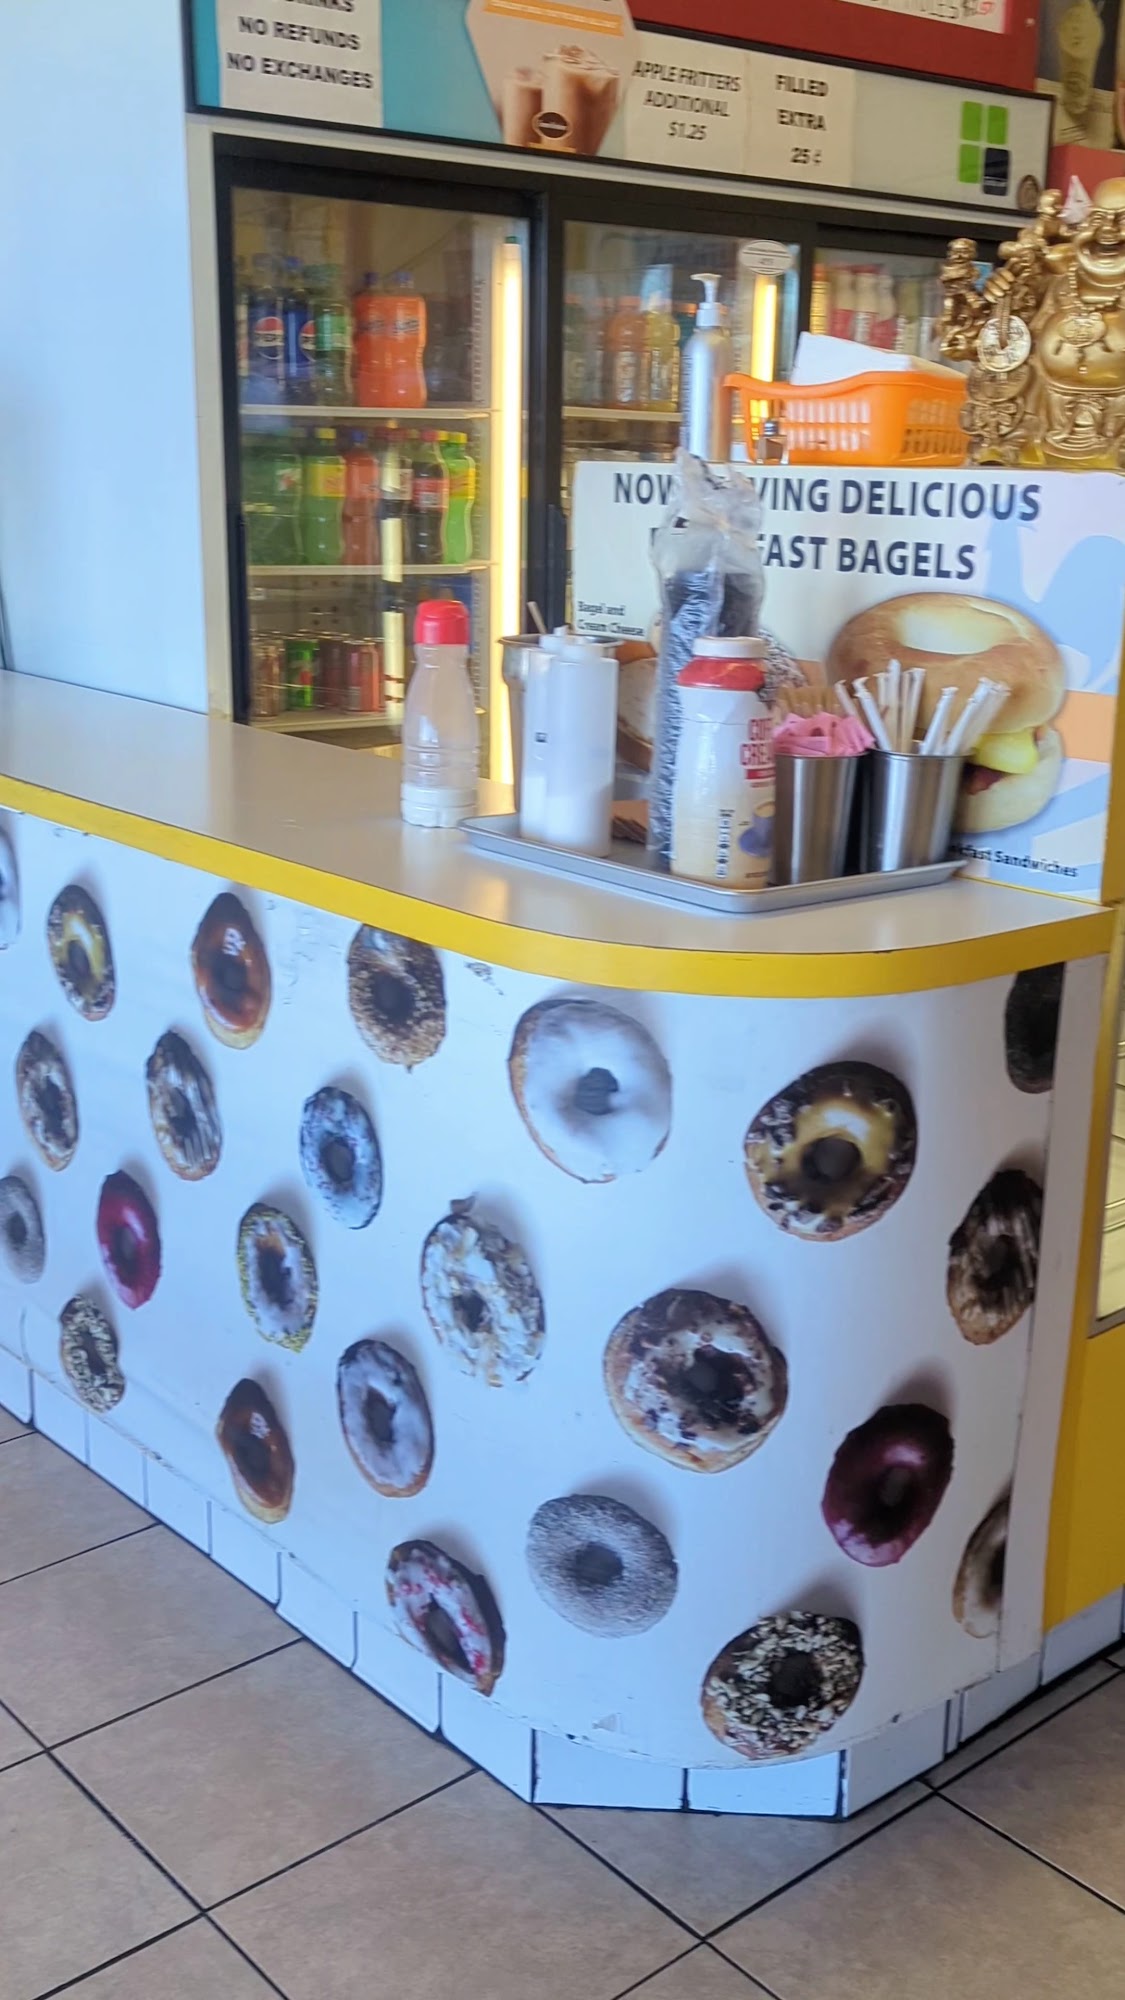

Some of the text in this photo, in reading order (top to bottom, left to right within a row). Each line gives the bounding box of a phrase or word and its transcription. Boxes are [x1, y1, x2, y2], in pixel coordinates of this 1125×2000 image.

[238, 16, 360, 50] NO REFUNDS
[227, 52, 374, 89] NO EXCHANGES
[632, 60, 742, 92] APPLE FRITTERS
[775, 74, 829, 97] FILLED
[643, 90, 730, 117] ADDITIONAL
[667, 121, 707, 140] $1.25
[776, 108, 827, 131] EXTRA
[790, 147, 810, 164] 25
[840, 479, 1042, 522] DELICIOUS
[837, 537, 977, 581] BAGELS
[578, 600, 626, 616] Bagel and
[578, 619, 645, 637] Cream Cheese
[994, 850, 1079, 877] Sandwiches
